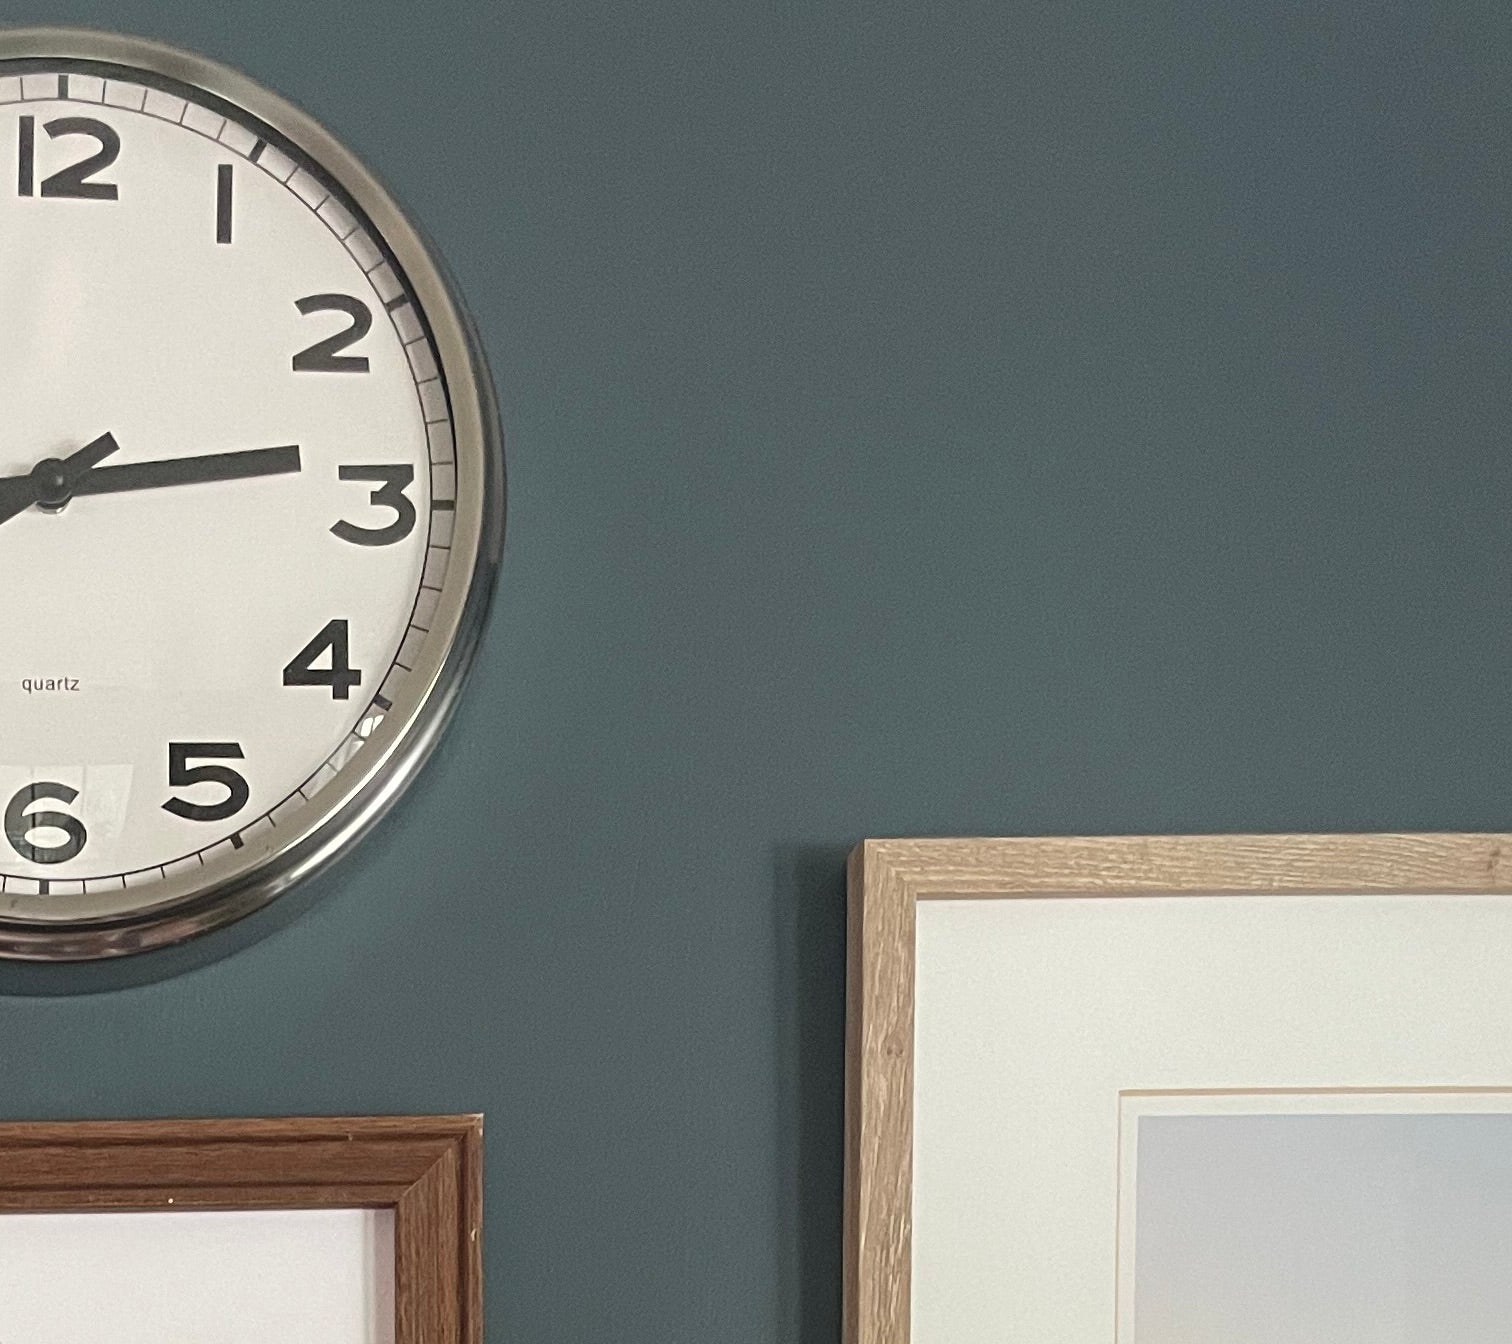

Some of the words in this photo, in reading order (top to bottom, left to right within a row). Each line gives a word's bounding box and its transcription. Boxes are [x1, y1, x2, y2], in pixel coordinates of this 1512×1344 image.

[17, 115, 121, 201] 12
[216, 163, 234, 245] 1
[291, 293, 373, 374] 2
[329, 463, 417, 547] 3
[21, 676, 80, 695] quartz
[282, 619, 362, 701] 4
[160, 741, 250, 822] 5
[3, 781, 88, 865] 6
